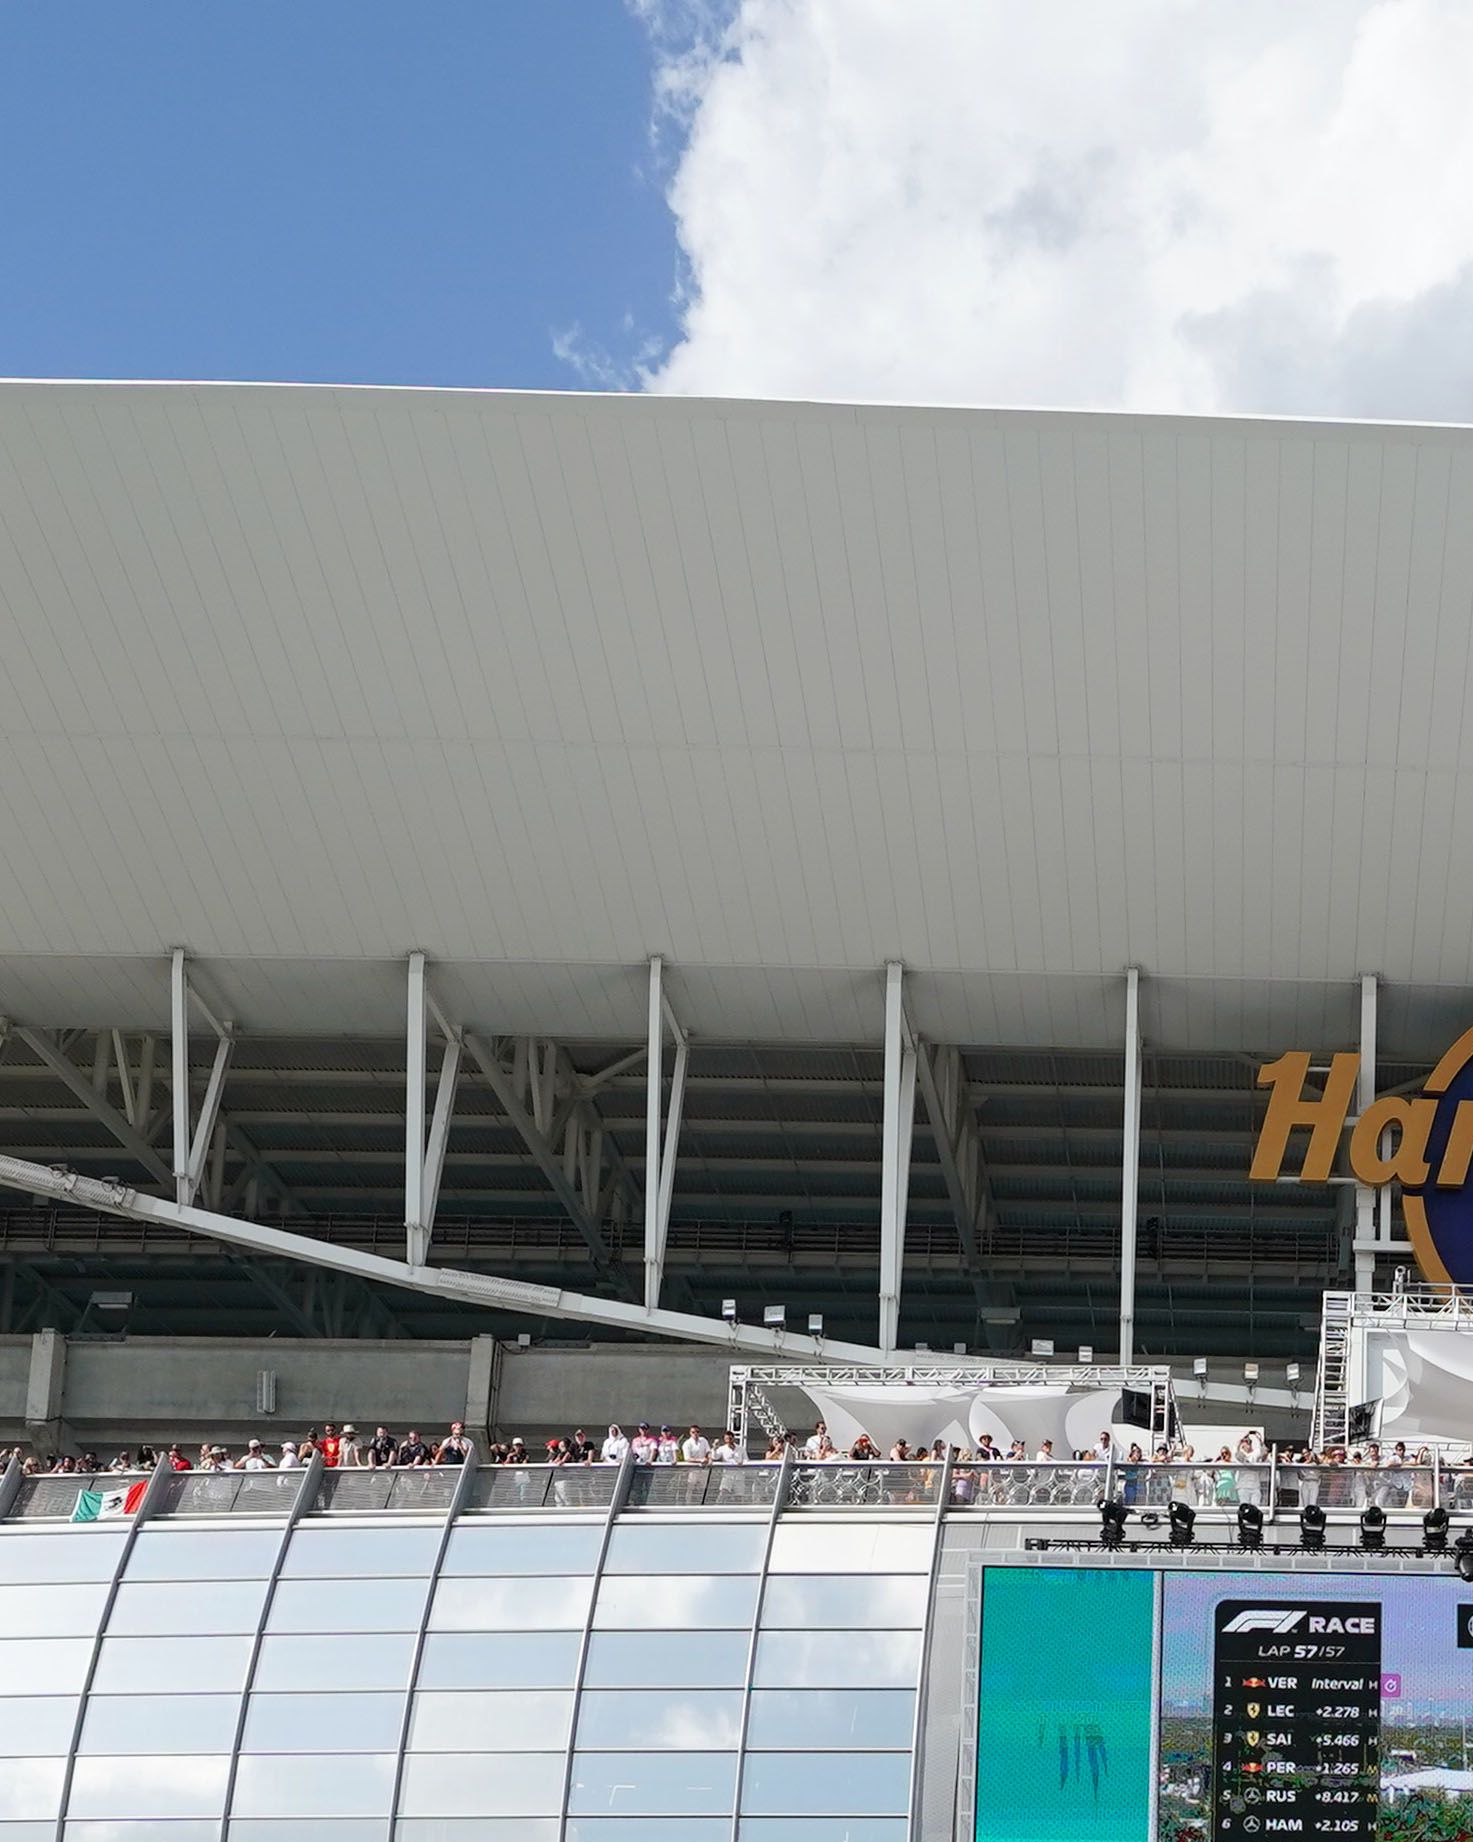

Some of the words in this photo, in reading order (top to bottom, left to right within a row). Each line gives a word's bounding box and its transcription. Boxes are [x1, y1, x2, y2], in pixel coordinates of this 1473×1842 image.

[1309, 1616, 1376, 1635] RACE
[1258, 1646, 1291, 1657] LAP
[1268, 1677, 1297, 1689] VER
[1312, 1678, 1363, 1691] Interval
[1267, 1705, 1294, 1718] LEC
[1267, 1733, 1291, 1745] SAI
[1267, 1762, 1296, 1774] PER
[1266, 1790, 1296, 1802] RUS
[1266, 1819, 1302, 1832] HAM
